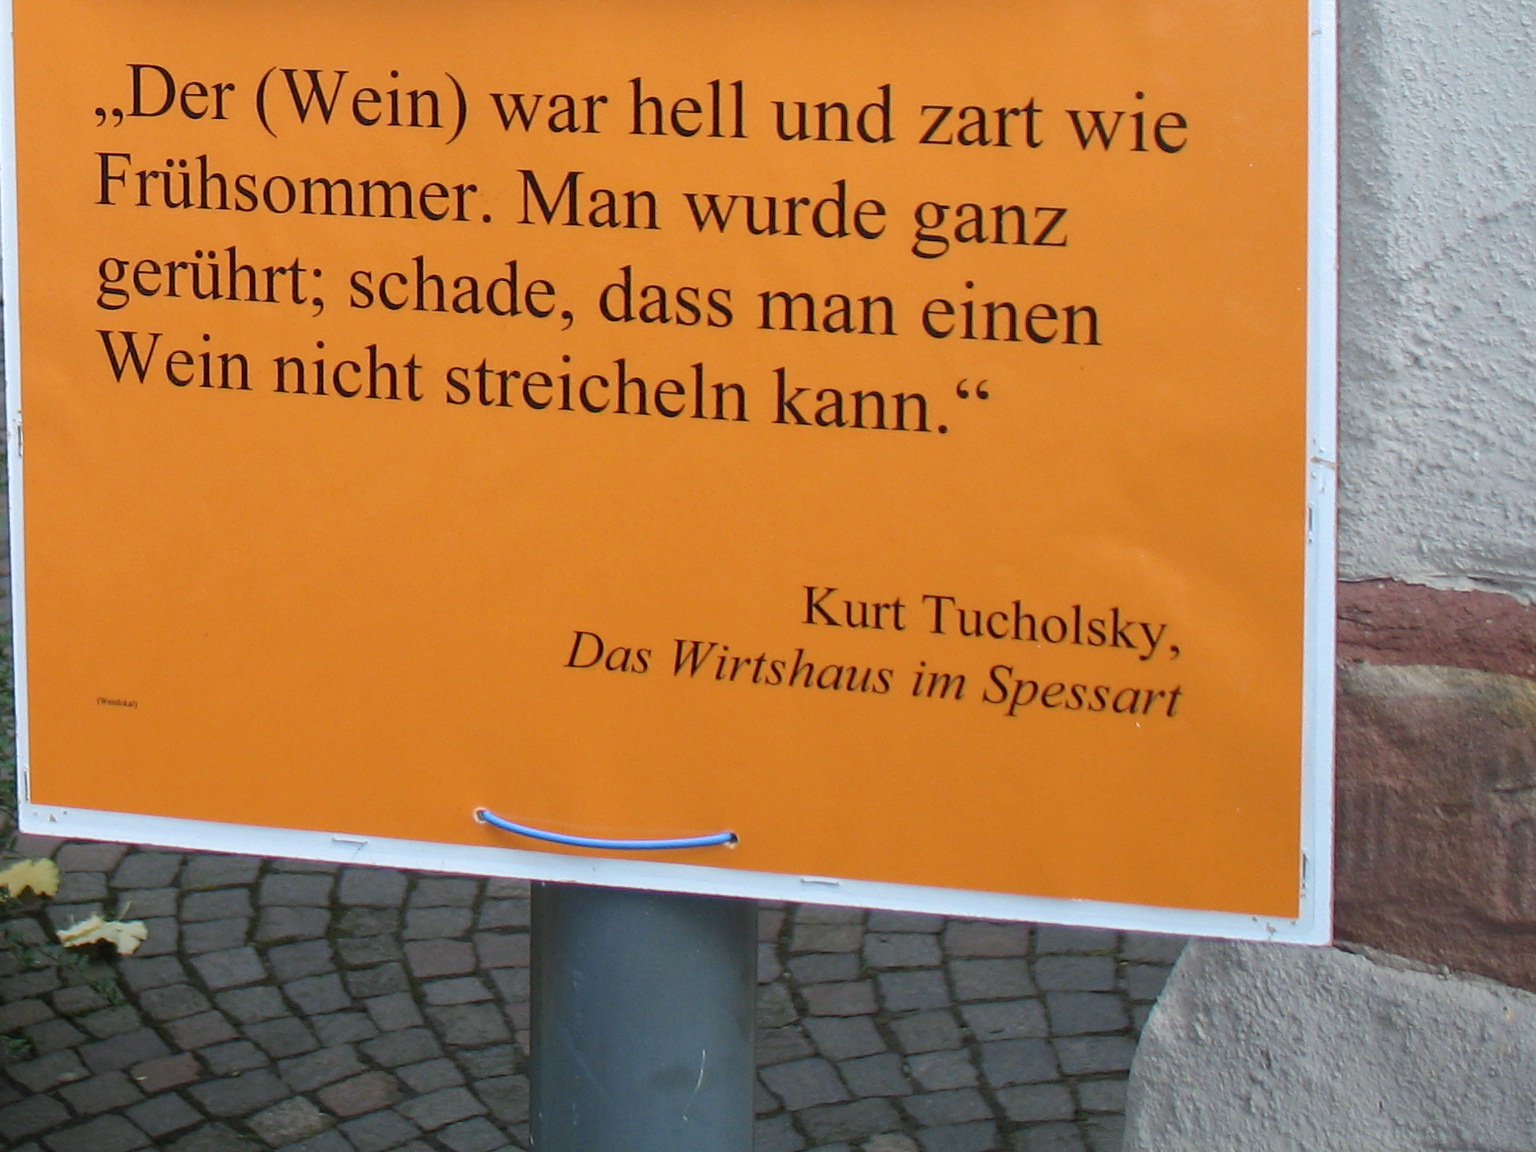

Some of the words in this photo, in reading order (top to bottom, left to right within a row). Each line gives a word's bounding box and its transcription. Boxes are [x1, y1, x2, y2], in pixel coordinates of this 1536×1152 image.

[95, 64, 235, 127] „Der
[257, 65, 466, 143] (Wein)
[490, 94, 607, 133] war
[630, 77, 746, 138] hell
[772, 84, 894, 143] und
[920, 98, 1042, 148] zart
[1066, 92, 1187, 153] wie
[96, 153, 491, 223] Frühsommer.
[518, 170, 660, 229] Man
[684, 180, 885, 239] wurde
[912, 202, 1067, 259] ganz
[97, 246, 323, 317] gerührt;
[351, 256, 573, 329] schade,
[600, 265, 732, 327] dass
[758, 291, 897, 335] man
[923, 281, 1101, 345] einen
[97, 330, 251, 390] Wein
[274, 341, 423, 401] nicht
[447, 355, 749, 421] streicheln
[804, 587, 905, 630] Kurt
[923, 595, 1179, 661] Tucholsky,
[566, 631, 651, 673] Das
[675, 640, 892, 693] Wirtshaus
[913, 662, 965, 699] im
[983, 665, 1181, 717] Spessart
